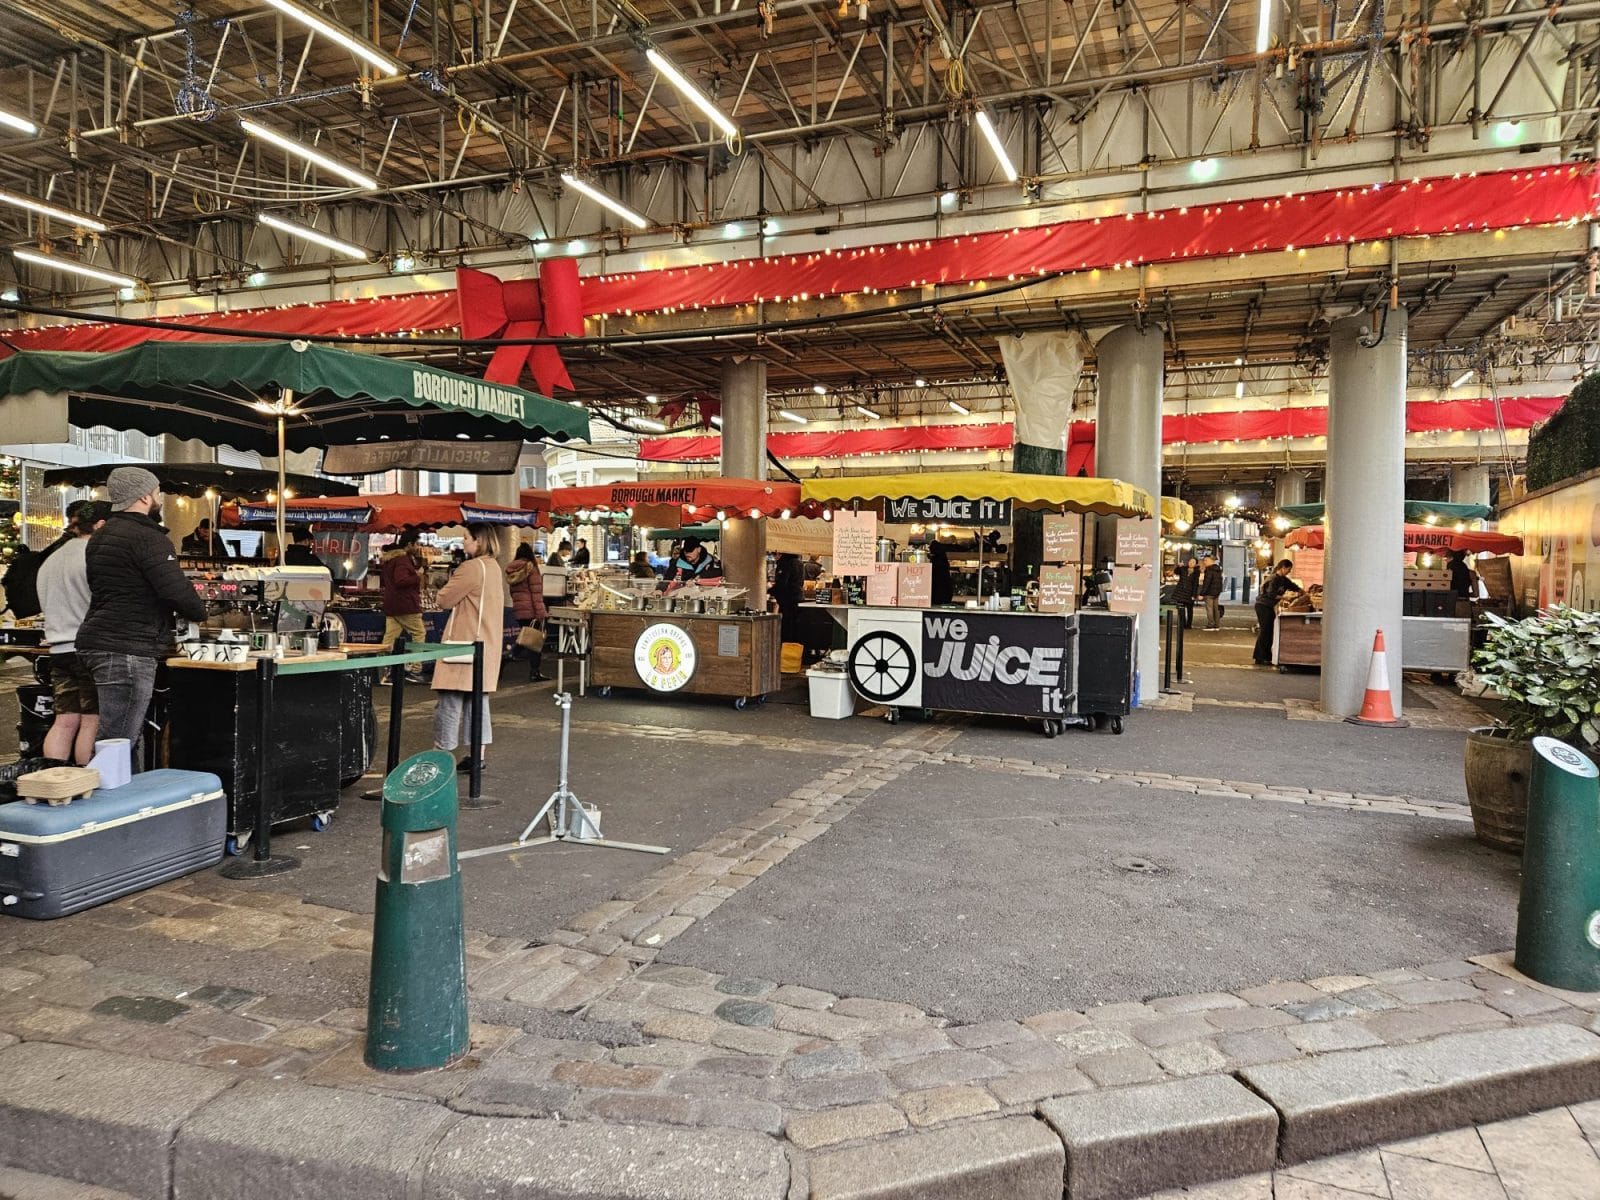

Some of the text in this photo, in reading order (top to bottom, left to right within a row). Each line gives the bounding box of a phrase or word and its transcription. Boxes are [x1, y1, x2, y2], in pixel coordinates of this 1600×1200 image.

[413, 370, 525, 419] BOROUGH MARKET
[611, 487, 697, 503] BOROUGH MARKET
[891, 498, 917, 518] WE
[922, 498, 972, 519] JUICE
[1415, 534, 1454, 547] MARKET
[875, 564, 891, 573] HOT
[906, 566, 926, 576] HOT
[903, 576, 922, 588] Apple
[924, 617, 968, 640] we
[1042, 687, 1064, 714] it
